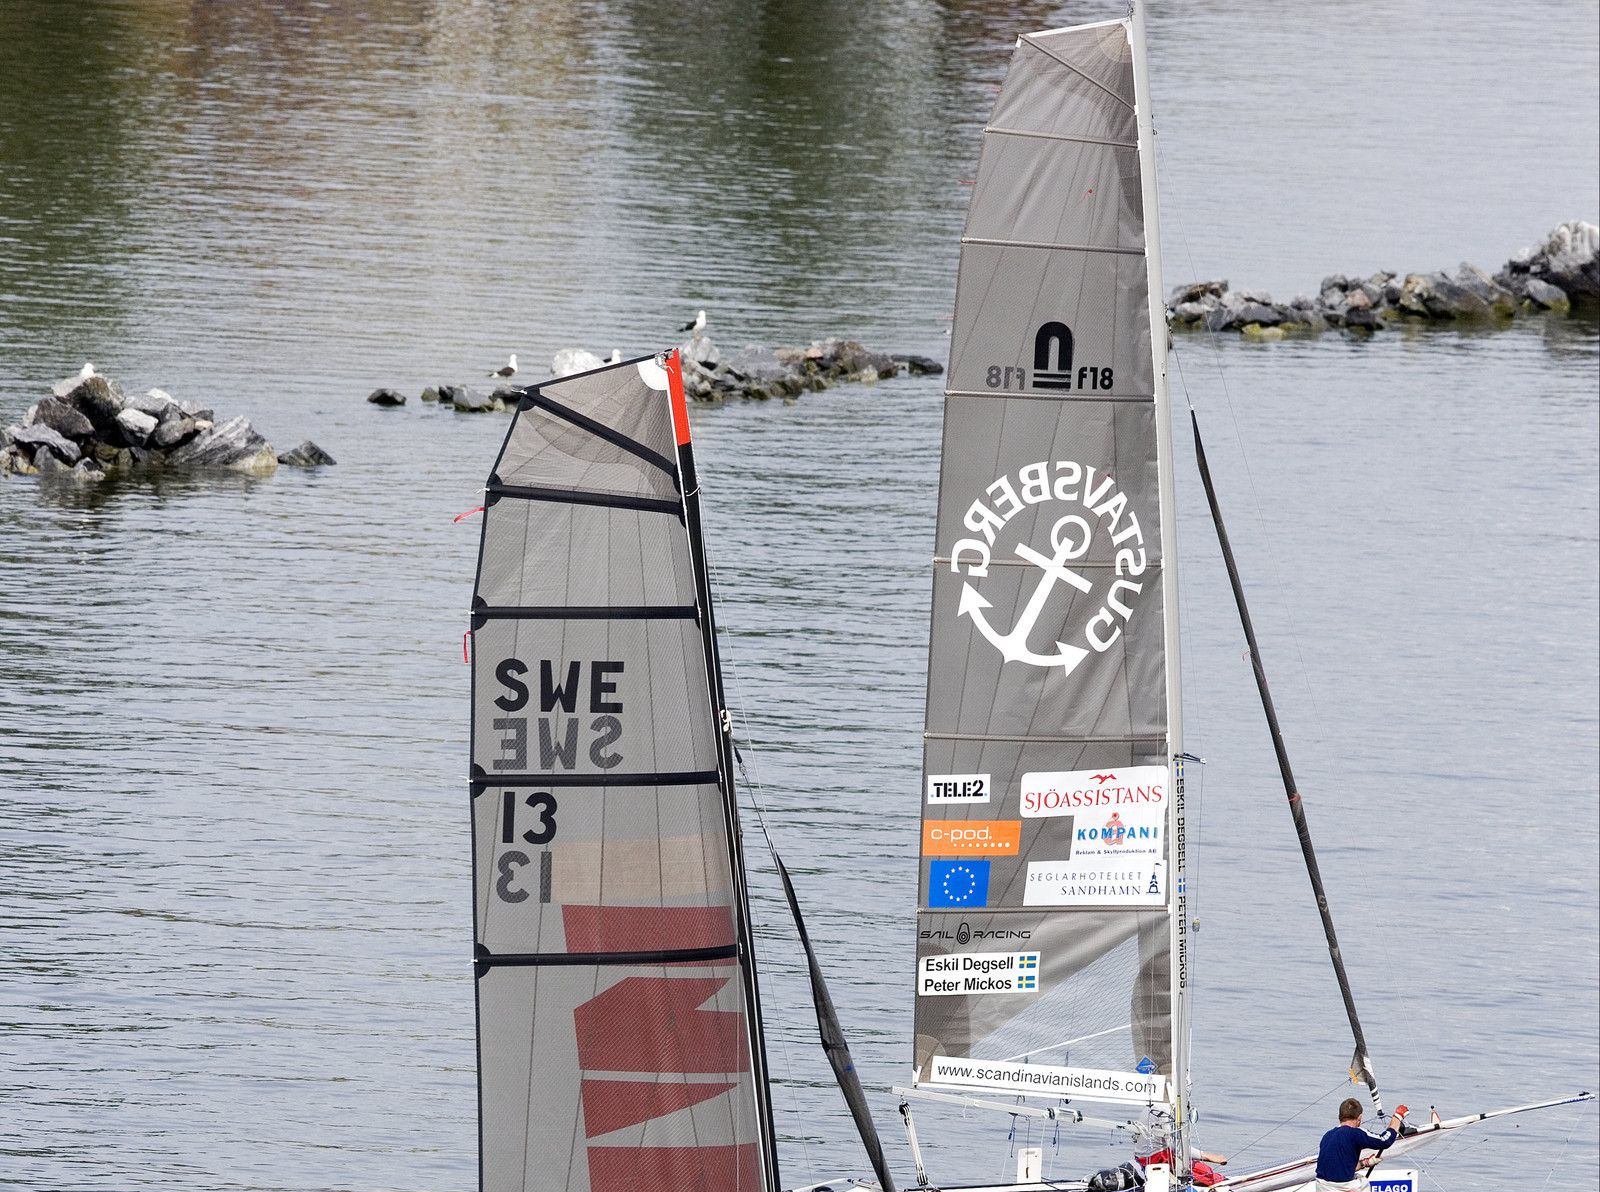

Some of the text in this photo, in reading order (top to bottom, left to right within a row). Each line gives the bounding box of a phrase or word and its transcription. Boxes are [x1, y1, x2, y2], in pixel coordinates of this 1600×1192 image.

[494, 658, 624, 713] SWE
[1024, 785, 1163, 812] SJÖASSISTANS
[502, 791, 557, 844] 13
[1077, 826, 1159, 841] KOMPANI
[1029, 871, 1142, 882] SEGLARHOTELLET
[1061, 885, 1142, 896] SANDHAMN
[919, 930, 1031, 939] SAIL RACING
[925, 956, 1014, 974] Eskil Degsell
[924, 977, 1012, 992] Peter Mickos
[937, 1064, 1157, 1094] www.scandinavianislands.com
